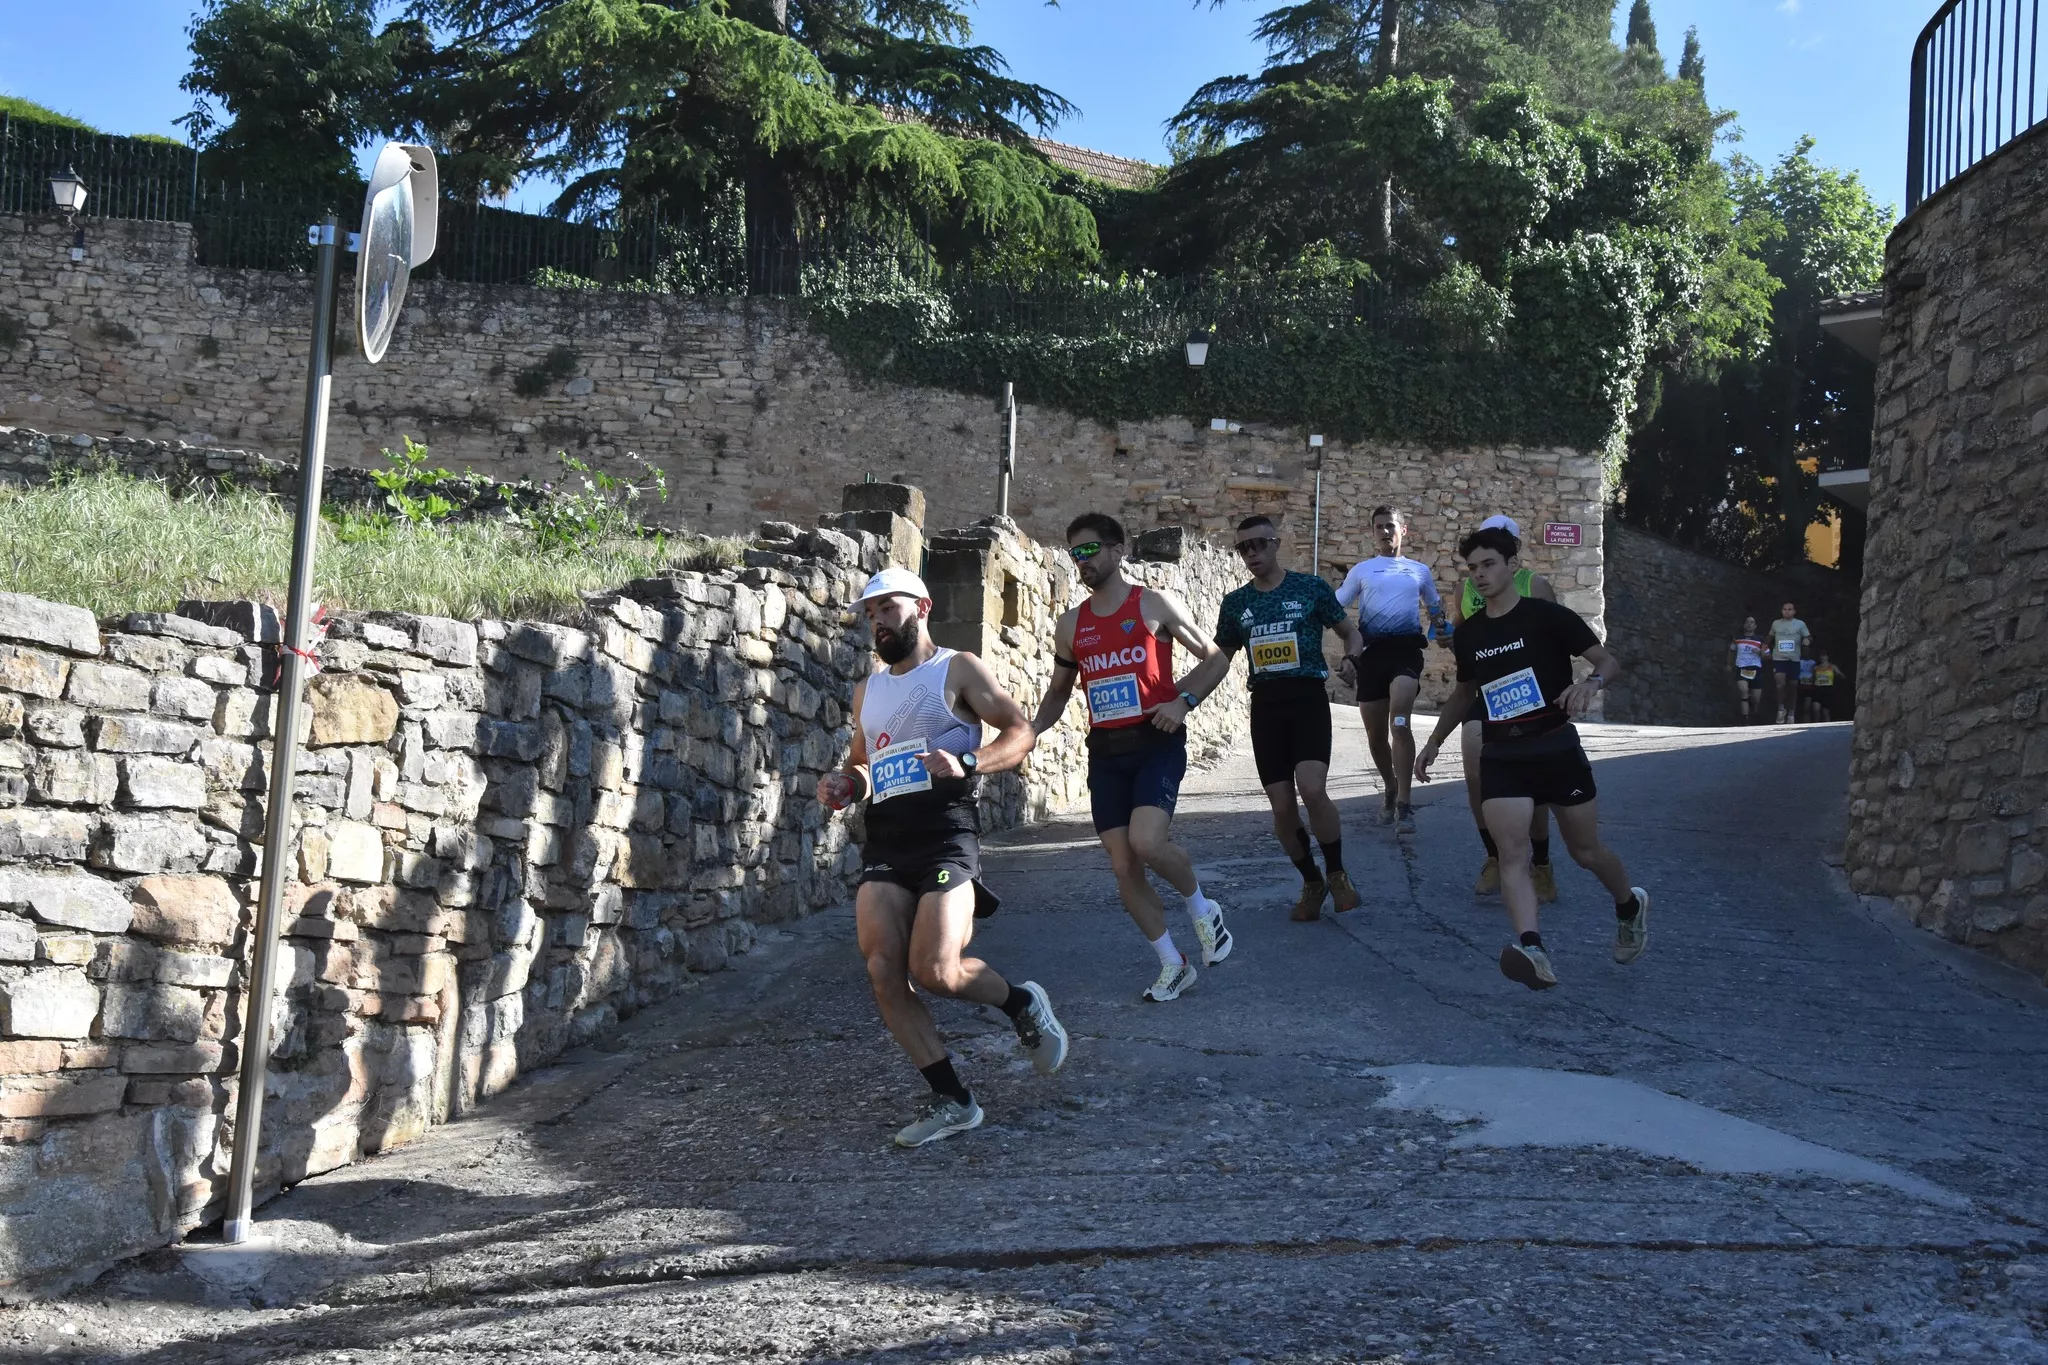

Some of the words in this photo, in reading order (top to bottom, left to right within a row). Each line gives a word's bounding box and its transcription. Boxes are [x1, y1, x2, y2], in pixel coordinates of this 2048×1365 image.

[1250, 620, 1294, 638] ATLEET
[1257, 646, 1291, 661] 1000
[1092, 686, 1129, 705] 2011
[1491, 683, 1532, 709] 2008
[875, 757, 920, 783] 2012
[883, 775, 911, 789] JAVIER
